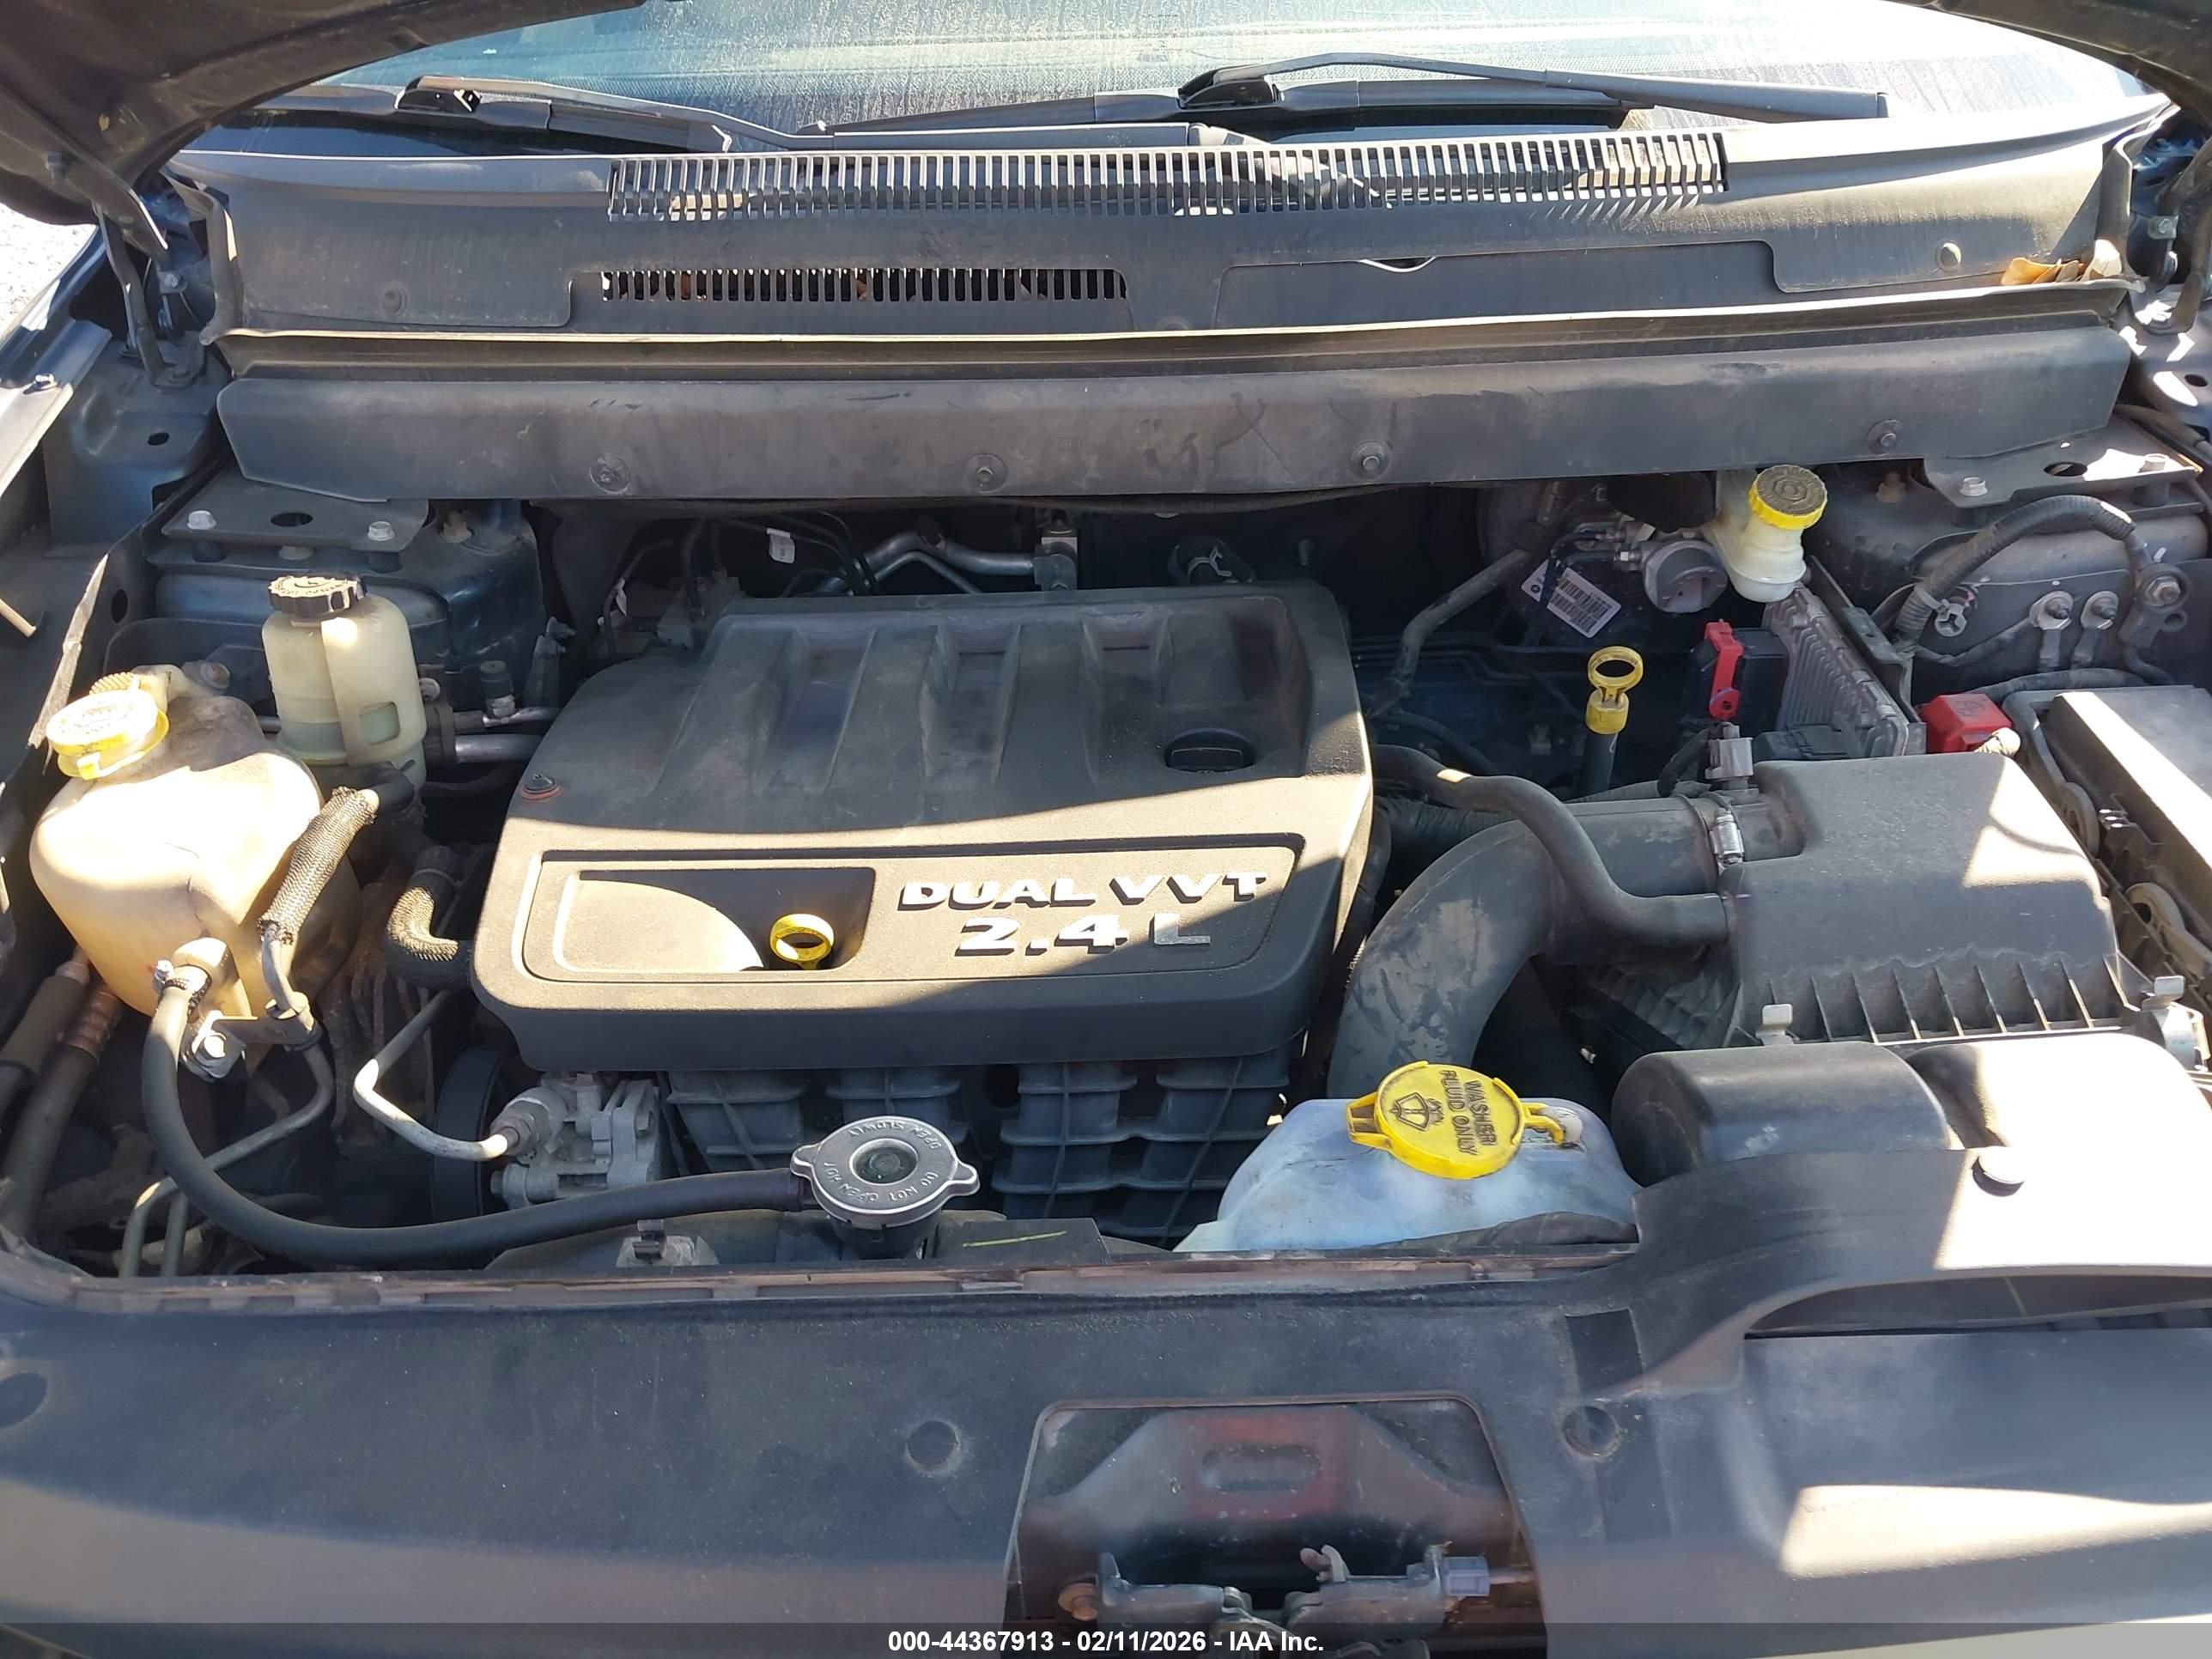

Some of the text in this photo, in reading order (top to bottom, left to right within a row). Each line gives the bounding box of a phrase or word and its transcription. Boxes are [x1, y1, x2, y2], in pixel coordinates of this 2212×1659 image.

[897, 872, 1267, 910] DUAL VVT
[1440, 1069, 1478, 1156] FLUID ONLY
[1465, 1079, 1497, 1146] WASHER
[848, 1120, 942, 1150] OPEN SLOWLY
[823, 1162, 939, 1202] DO NOT OPEN HOT
